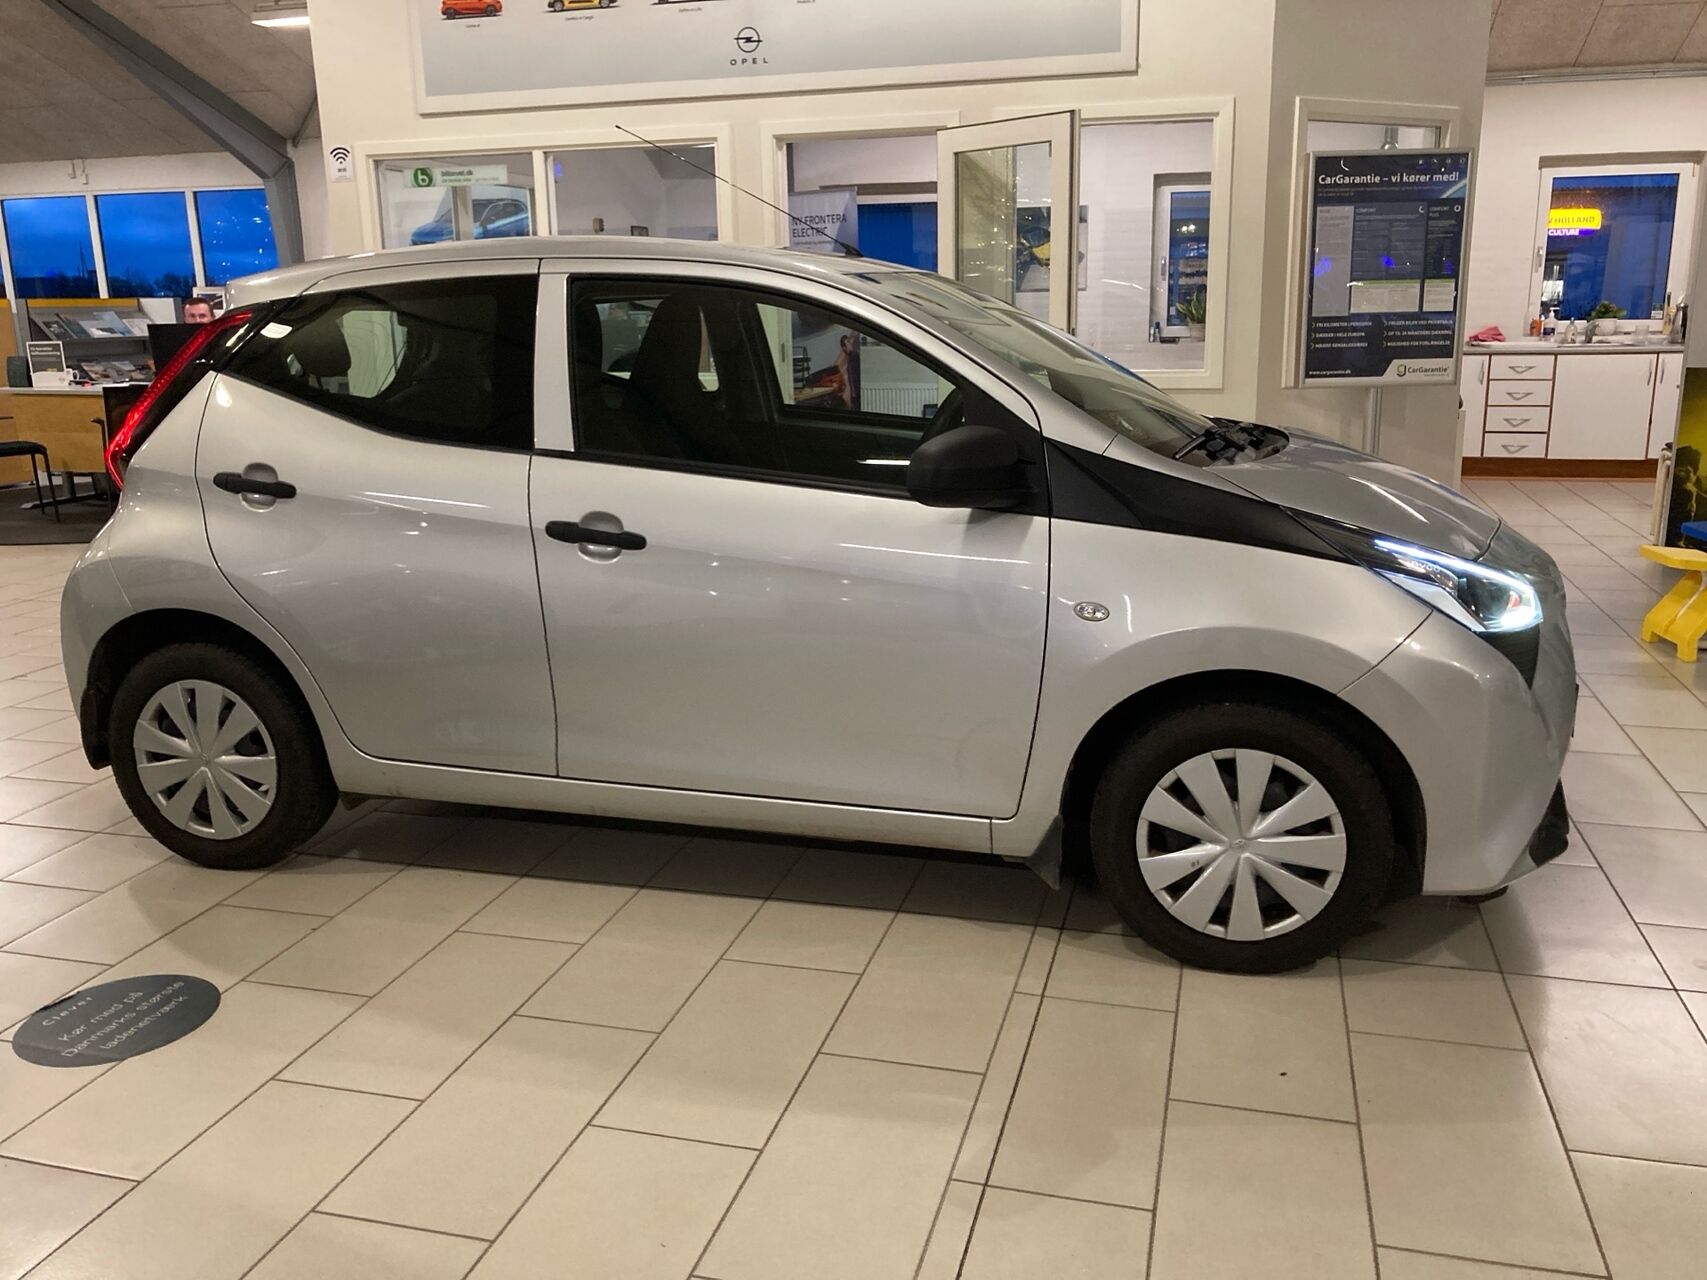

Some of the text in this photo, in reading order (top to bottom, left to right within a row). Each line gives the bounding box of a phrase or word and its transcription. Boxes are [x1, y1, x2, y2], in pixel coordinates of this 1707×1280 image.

[730, 57, 769, 66] OPEL
[1318, 173, 1381, 185] CarGarantie
[1391, 173, 1400, 183] vi
[1403, 172, 1431, 183] kører
[1433, 171, 1460, 182] med!
[804, 213, 847, 225] FRONTERA
[1553, 215, 1595, 224] HOLLAND
[1407, 365, 1448, 374] CarGarantie
[42, 997, 94, 1026] Clever
[58, 992, 144, 1042] Kør med på
[61, 981, 185, 1057] Danmarks største
